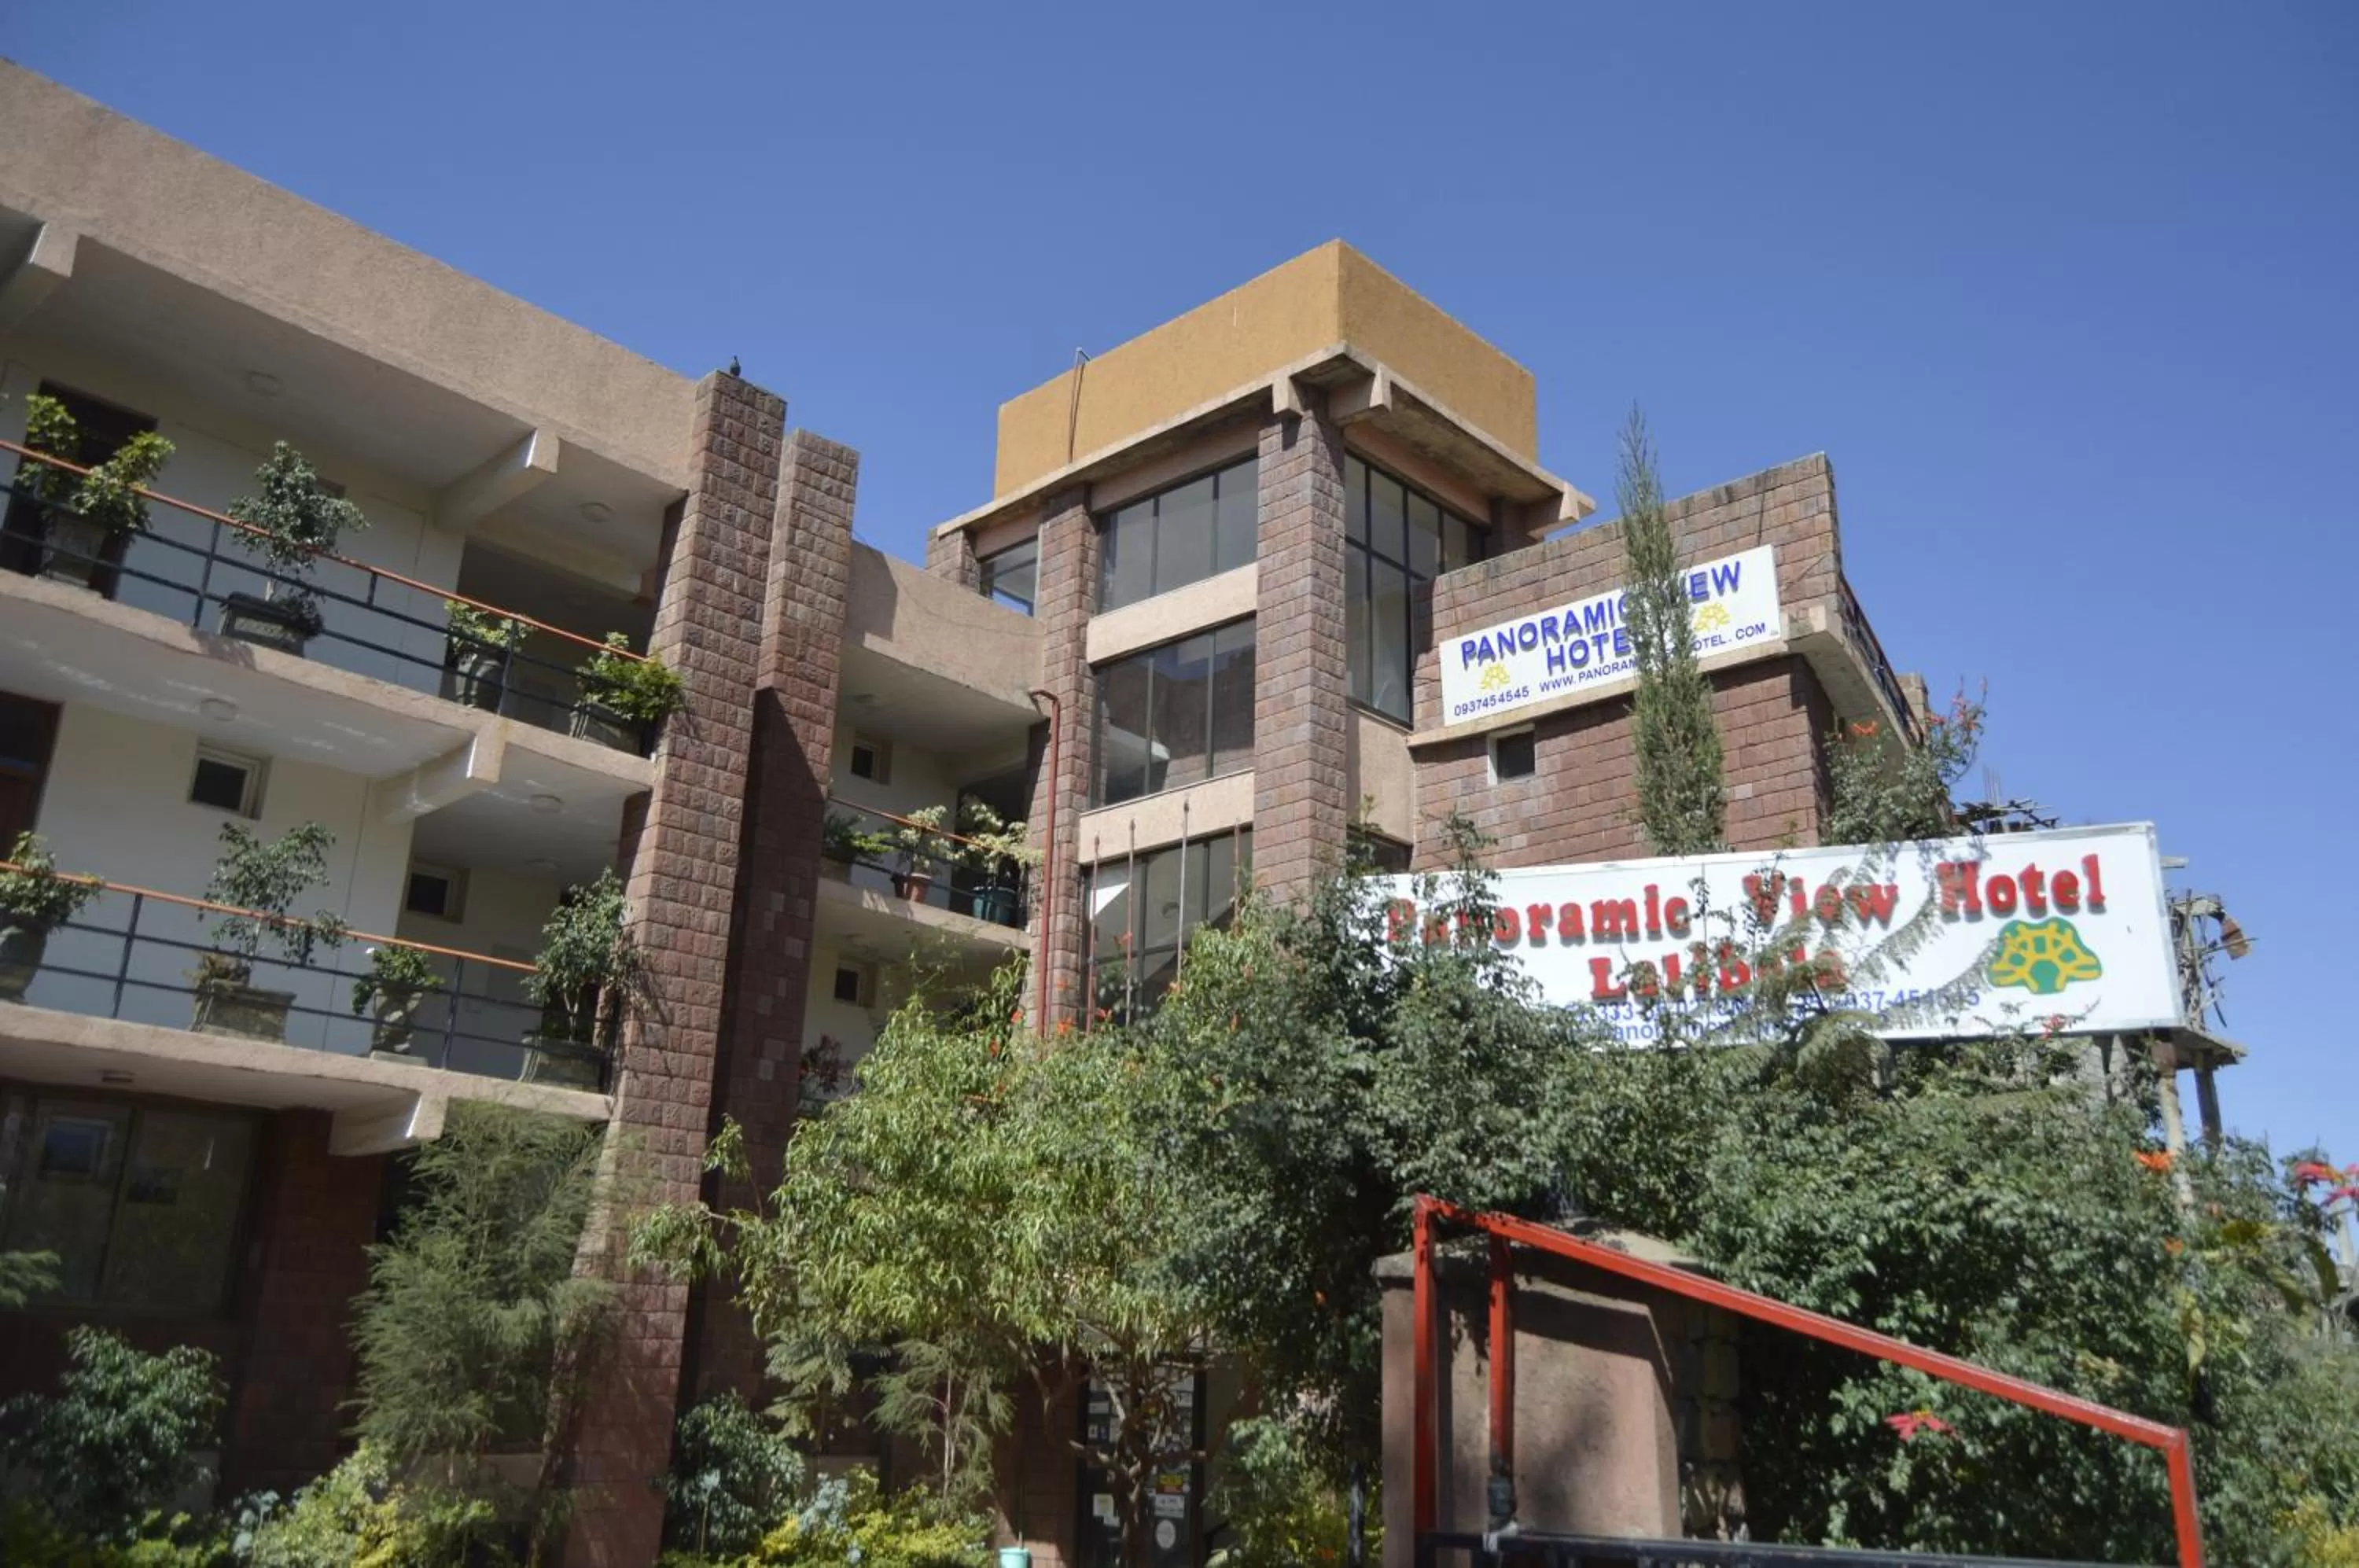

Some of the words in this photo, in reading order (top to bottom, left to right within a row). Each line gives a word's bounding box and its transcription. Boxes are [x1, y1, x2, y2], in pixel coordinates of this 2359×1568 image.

[1546, 626, 1636, 676] HOTE
[1454, 686, 1529, 716] 0937454545
[1741, 870, 1900, 929] View
[1935, 853, 2107, 922] Hotel
[1588, 941, 1846, 1000] Laliba
